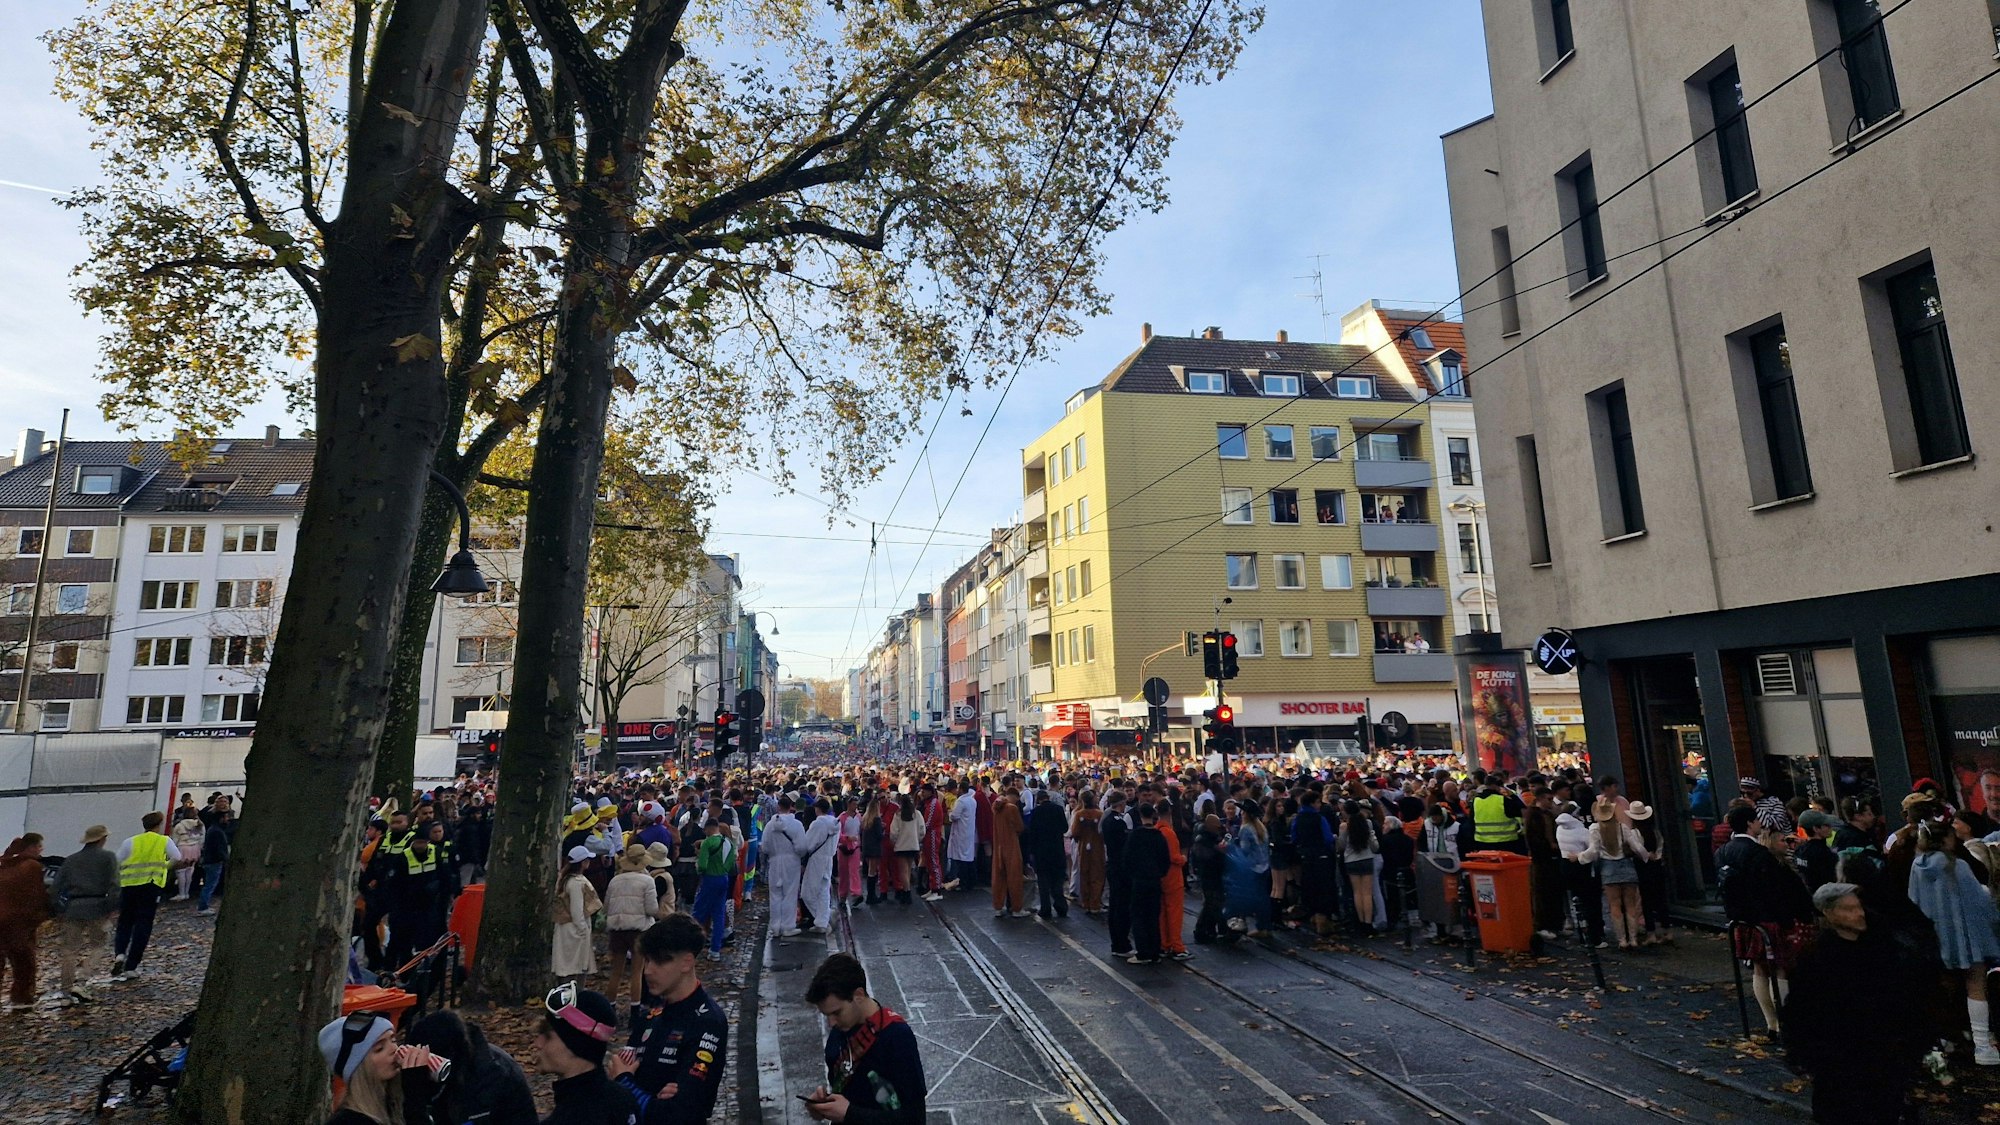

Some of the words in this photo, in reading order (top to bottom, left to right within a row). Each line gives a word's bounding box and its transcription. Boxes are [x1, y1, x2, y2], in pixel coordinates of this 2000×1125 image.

[1476, 671, 1490, 679] DE
[1491, 670, 1516, 679] KING
[1280, 702, 1340, 715] SHOOTER
[1342, 702, 1366, 714] BAR
[623, 723, 652, 736] ONE
[1954, 726, 1999, 747] mangal
